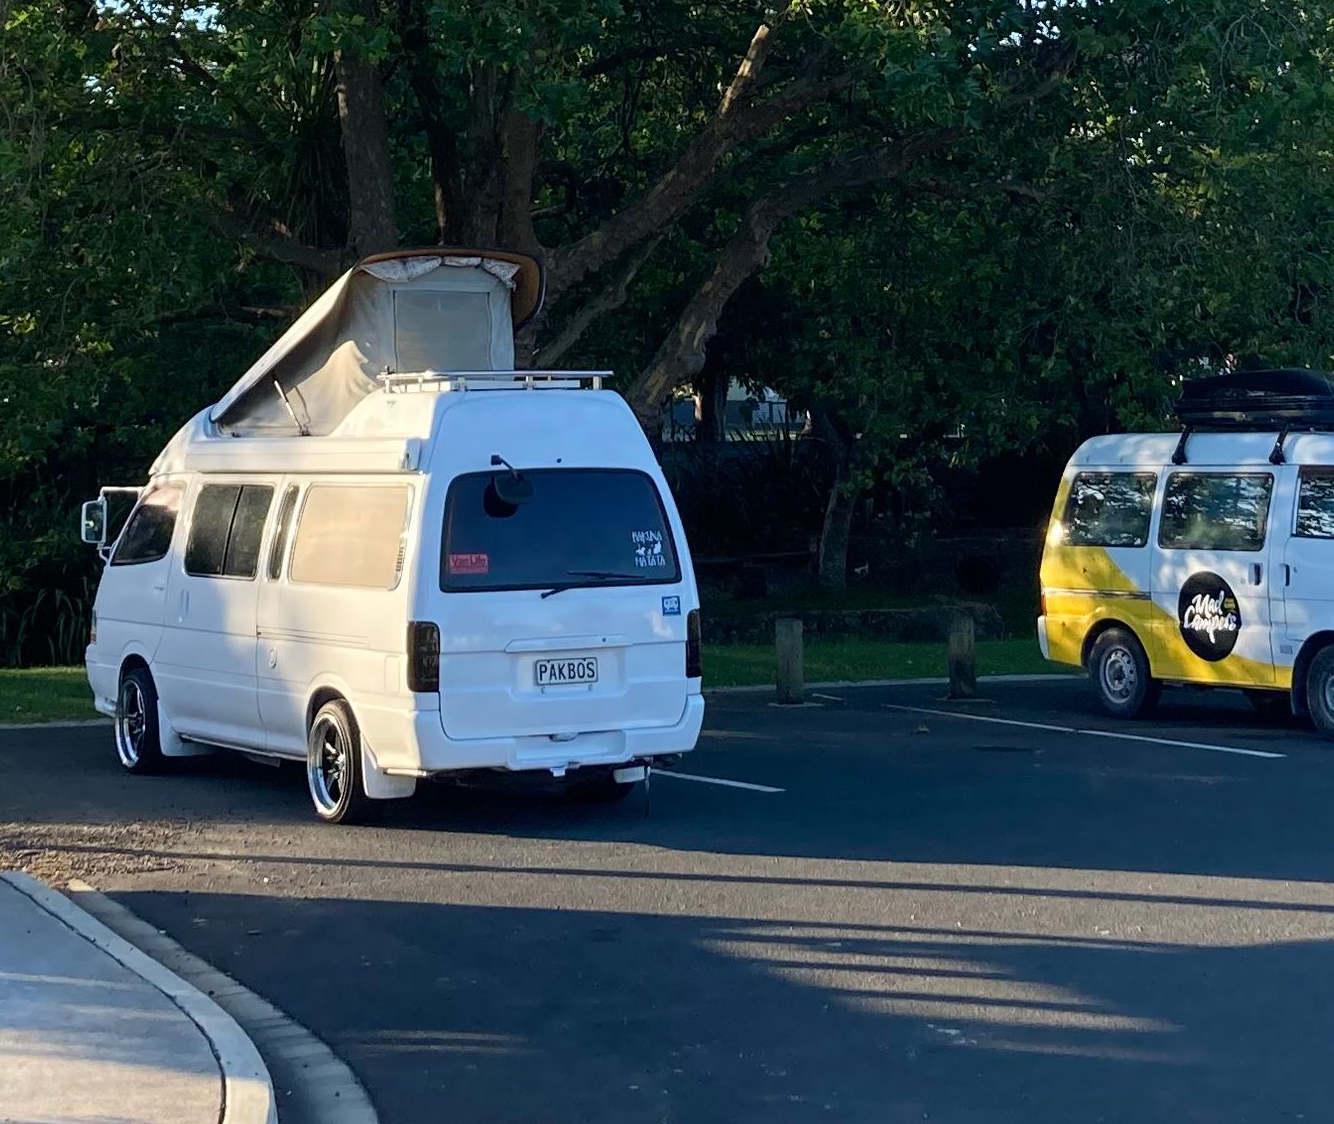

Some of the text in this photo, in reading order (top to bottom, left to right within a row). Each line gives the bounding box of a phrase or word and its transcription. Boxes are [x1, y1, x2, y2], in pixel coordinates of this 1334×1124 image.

[1191, 590, 1225, 618] Mad
[1183, 605, 1237, 644] Campers
[539, 661, 595, 681] PAKBOS
